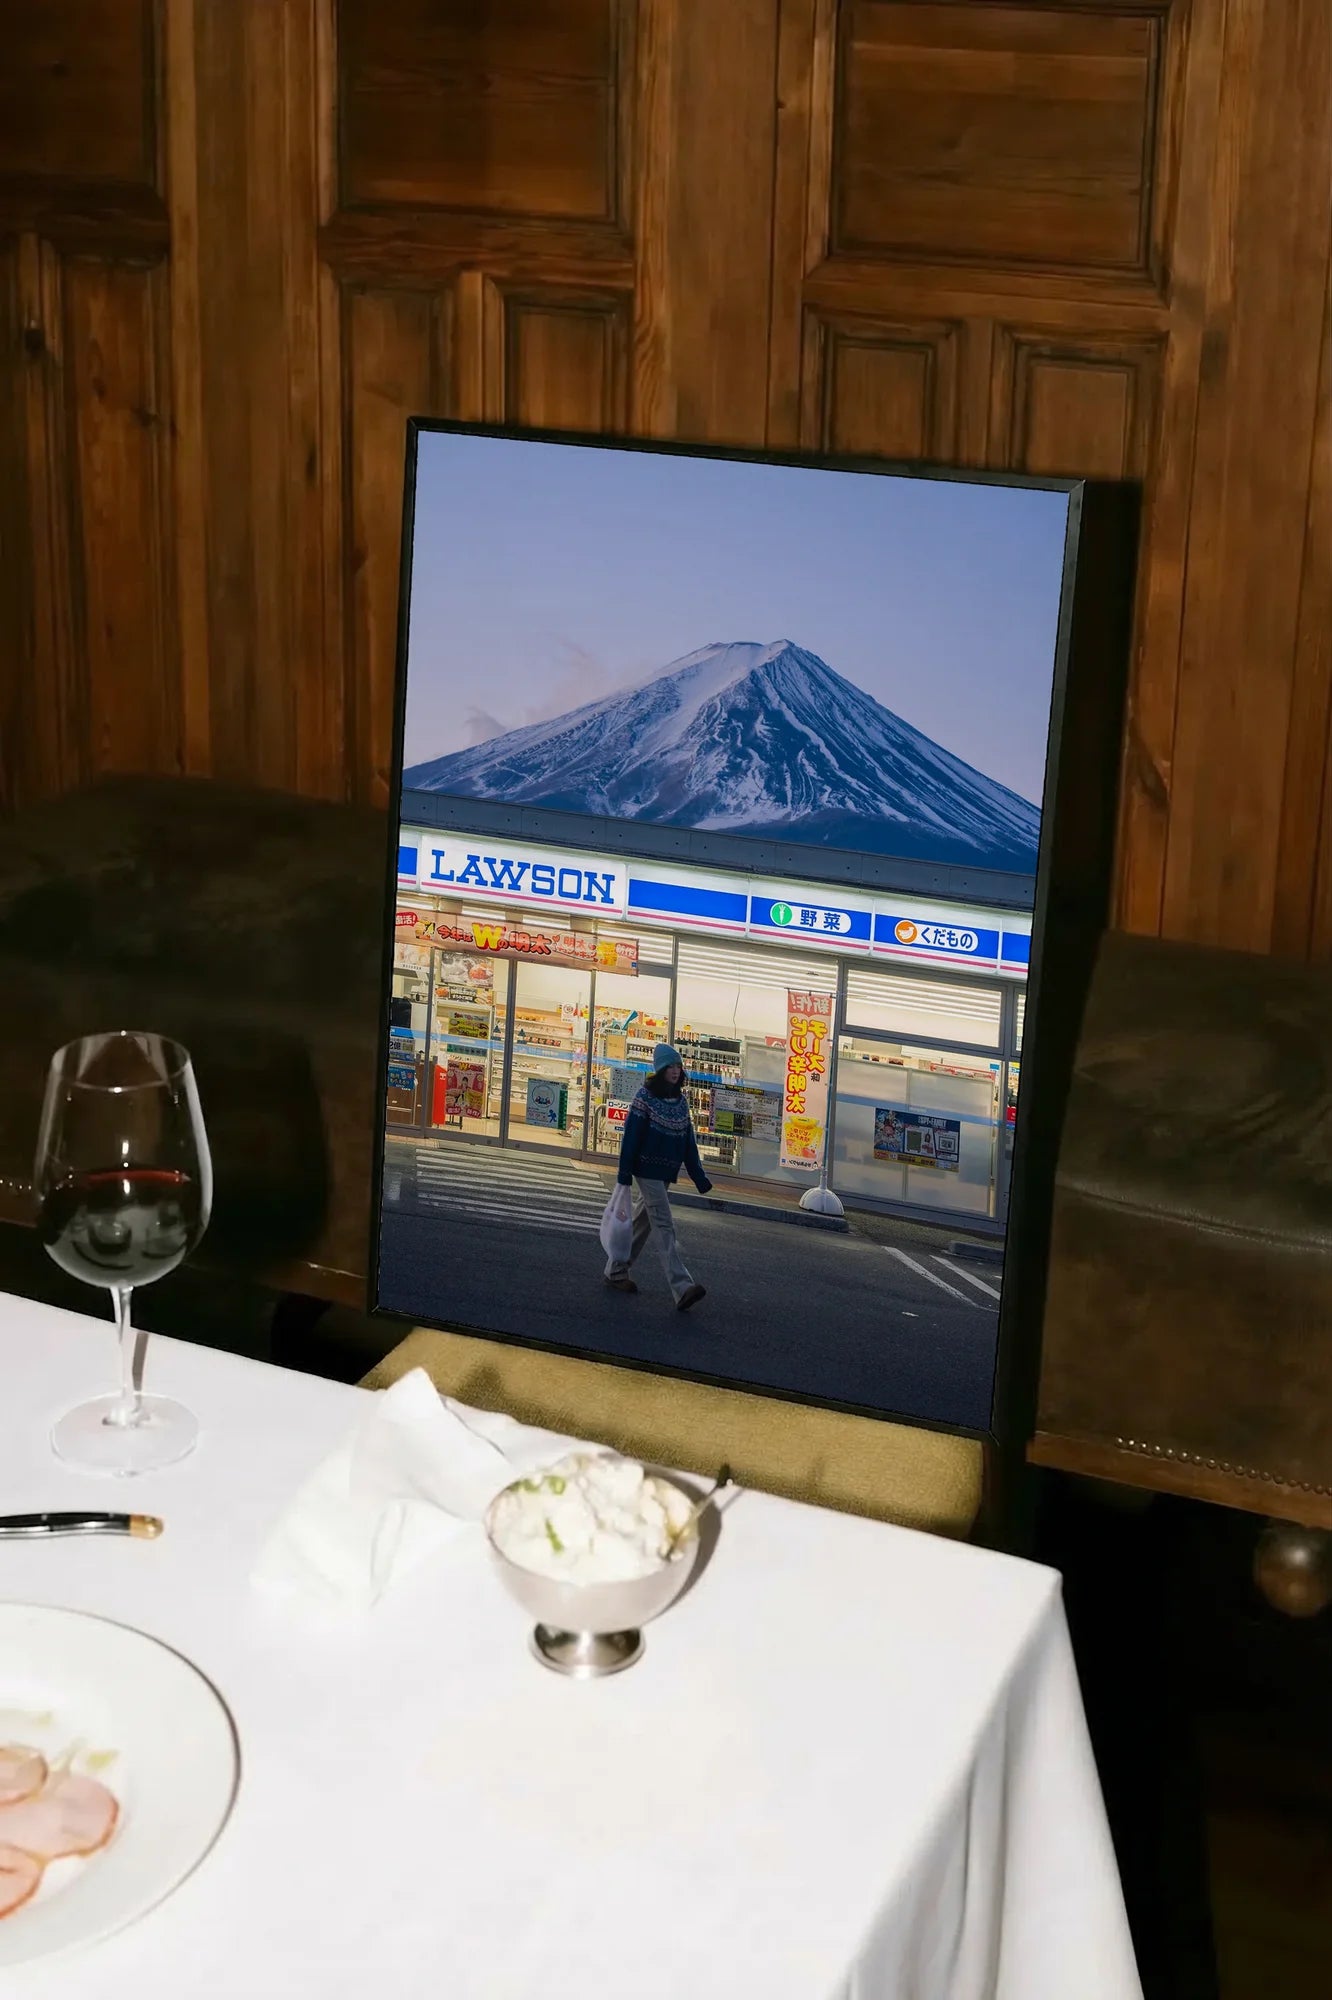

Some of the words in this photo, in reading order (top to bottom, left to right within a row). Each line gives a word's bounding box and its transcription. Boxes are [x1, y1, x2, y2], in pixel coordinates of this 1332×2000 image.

[431, 849, 615, 904] LAWSON
[800, 909, 840, 931] 野菜
[921, 926, 973, 949] くだもの
[613, 1110, 628, 1120] AT
